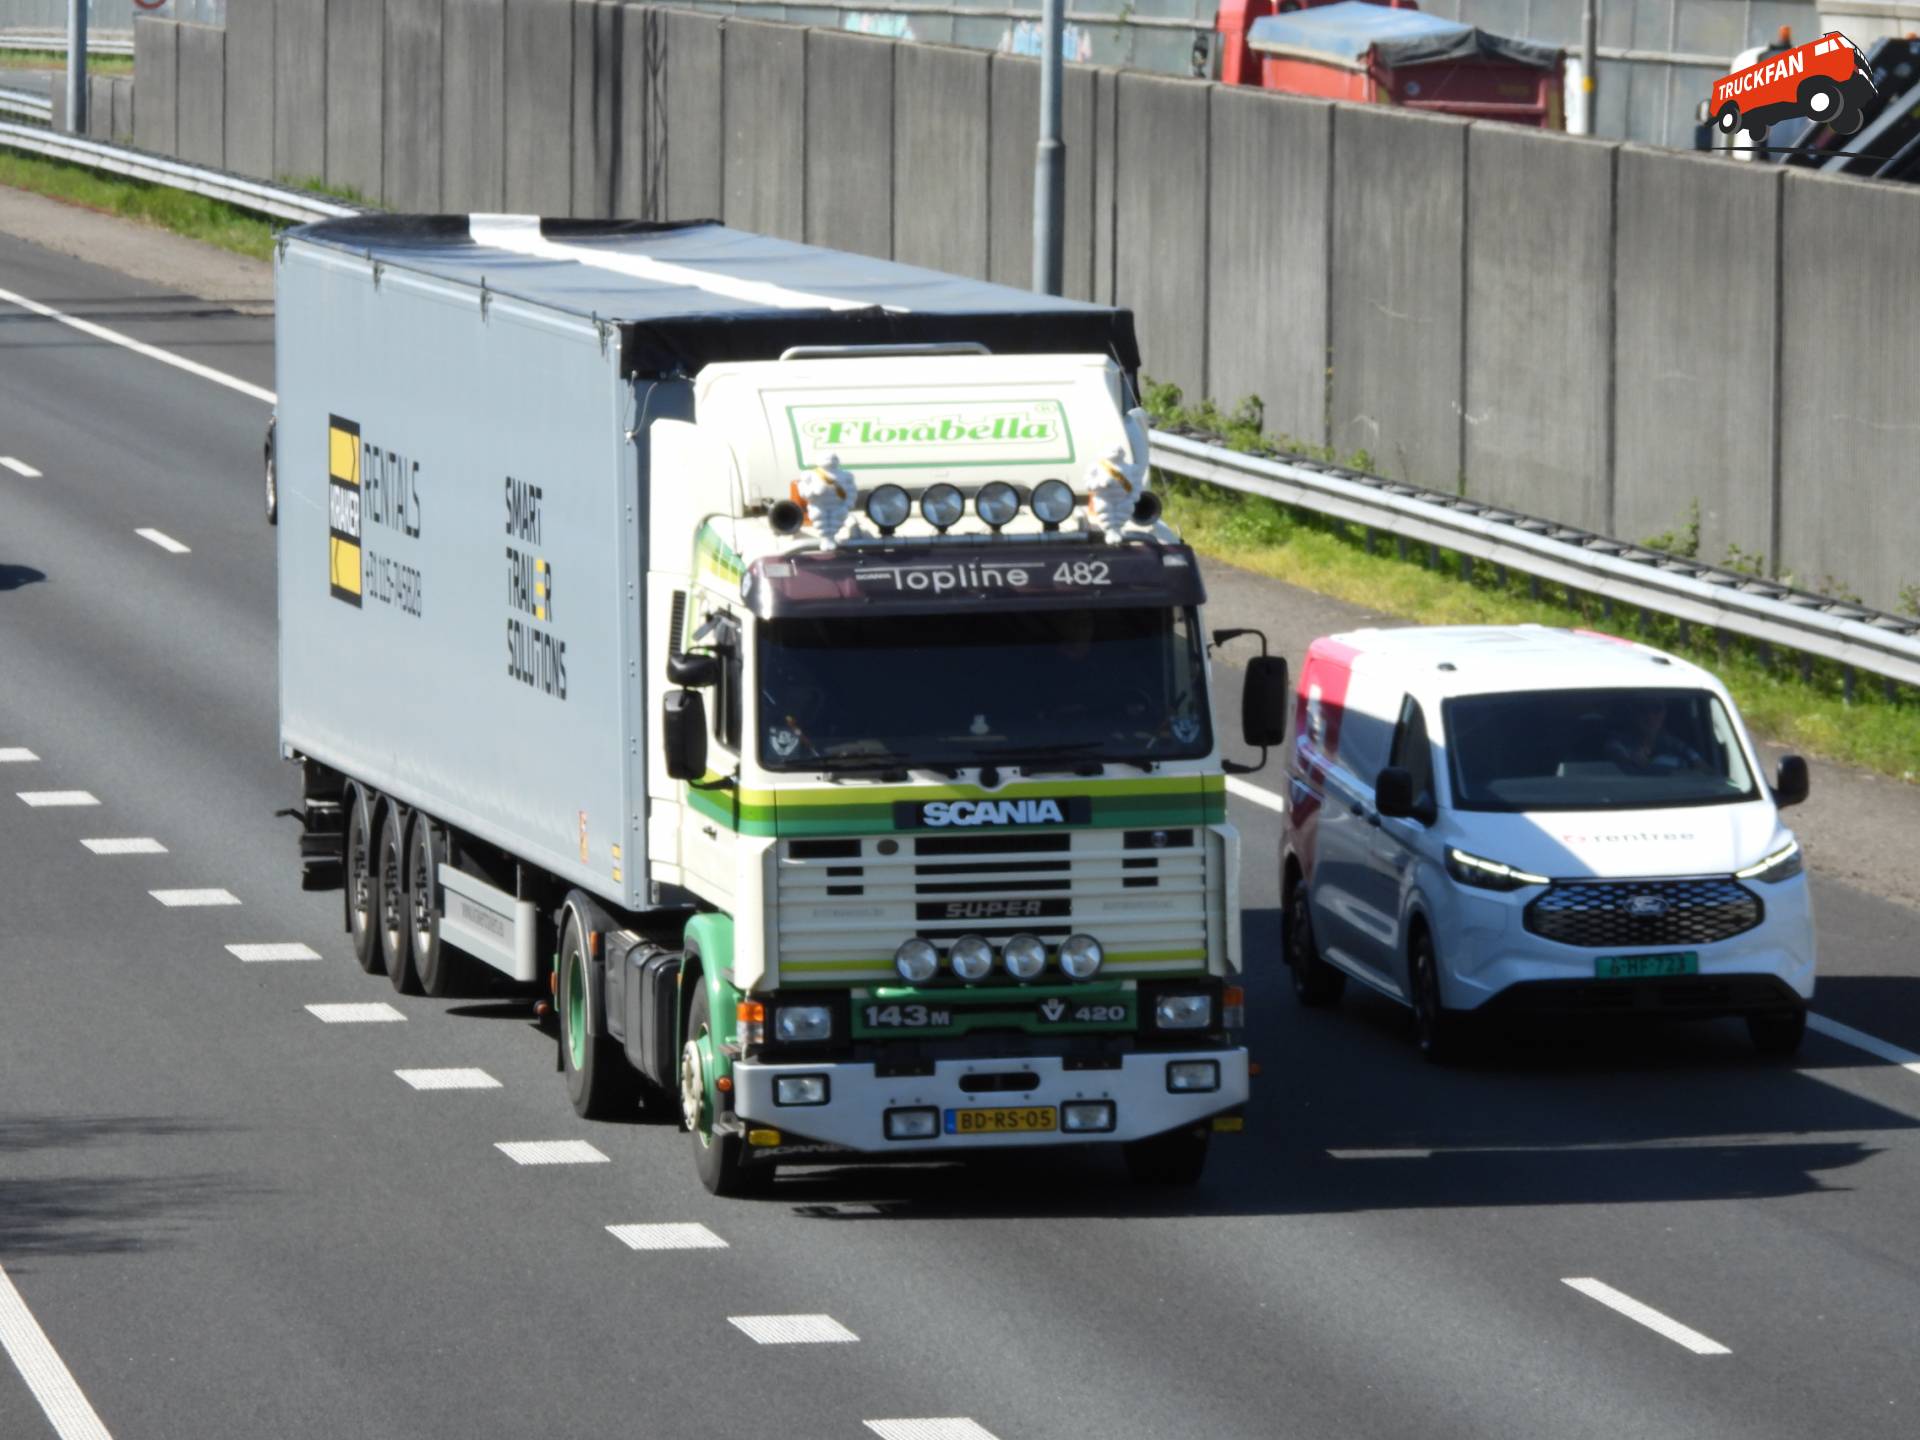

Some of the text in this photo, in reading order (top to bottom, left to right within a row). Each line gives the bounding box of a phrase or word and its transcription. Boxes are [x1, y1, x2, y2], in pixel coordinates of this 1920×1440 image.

[812, 416, 1050, 443] Florabella
[363, 442, 420, 539] RENTALS
[505, 476, 542, 546] SMART
[506, 547, 552, 622] TRAILER
[856, 562, 1111, 593] Topline 482
[507, 618, 567, 701] SOLUTIONS
[923, 799, 1064, 827] SCANIA
[945, 900, 1042, 919] SUPER
[1075, 1005, 1126, 1021] 420
[961, 1110, 1052, 1130] BD-RS-05
